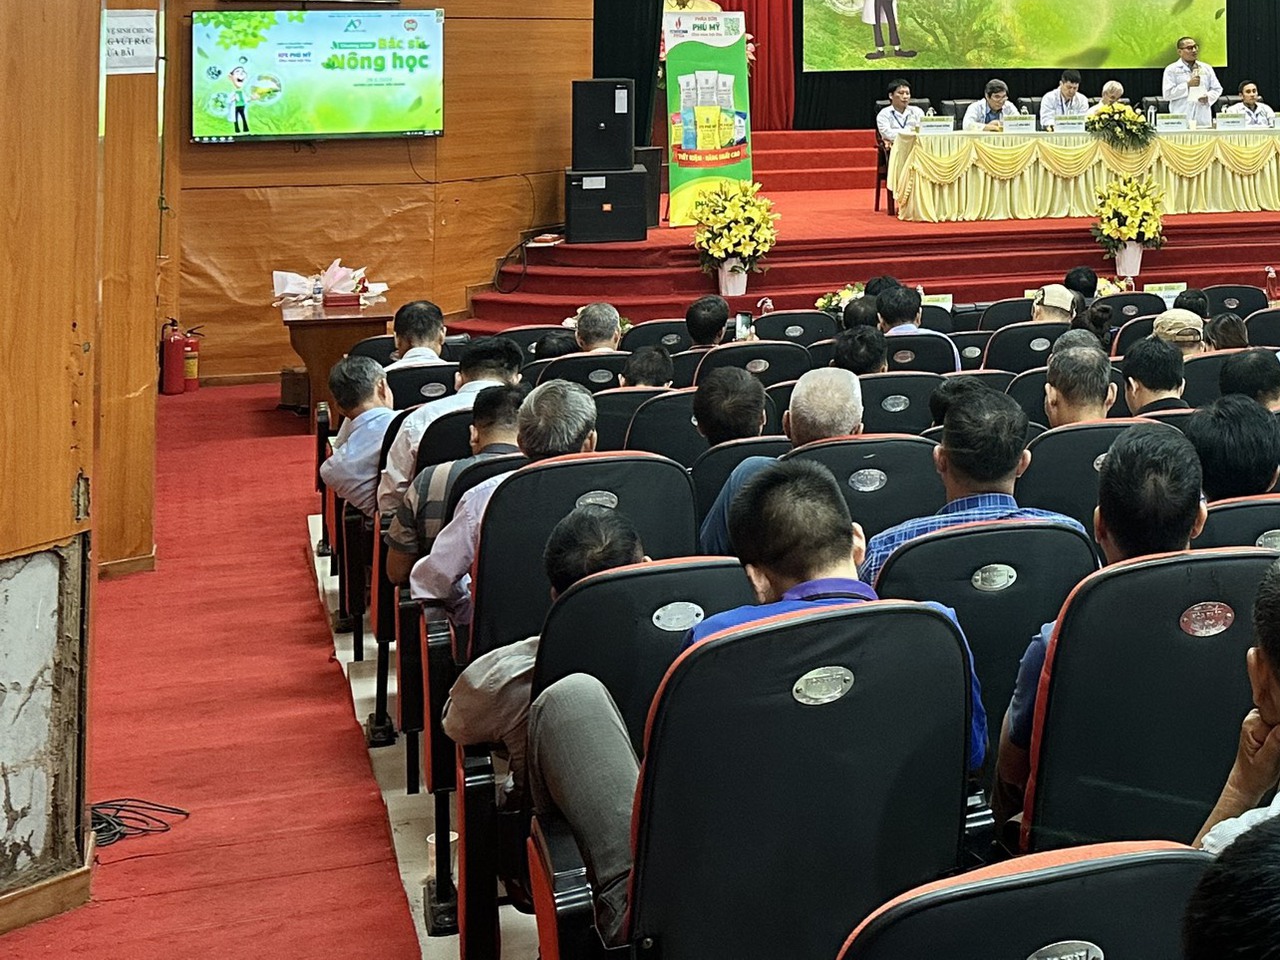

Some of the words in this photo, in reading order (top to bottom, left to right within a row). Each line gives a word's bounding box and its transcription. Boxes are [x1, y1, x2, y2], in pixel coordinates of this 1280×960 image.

[692, 23, 708, 31] PHÚ
[709, 22, 720, 31] MỸ
[332, 52, 385, 72] Nông
[392, 52, 429, 72] học
